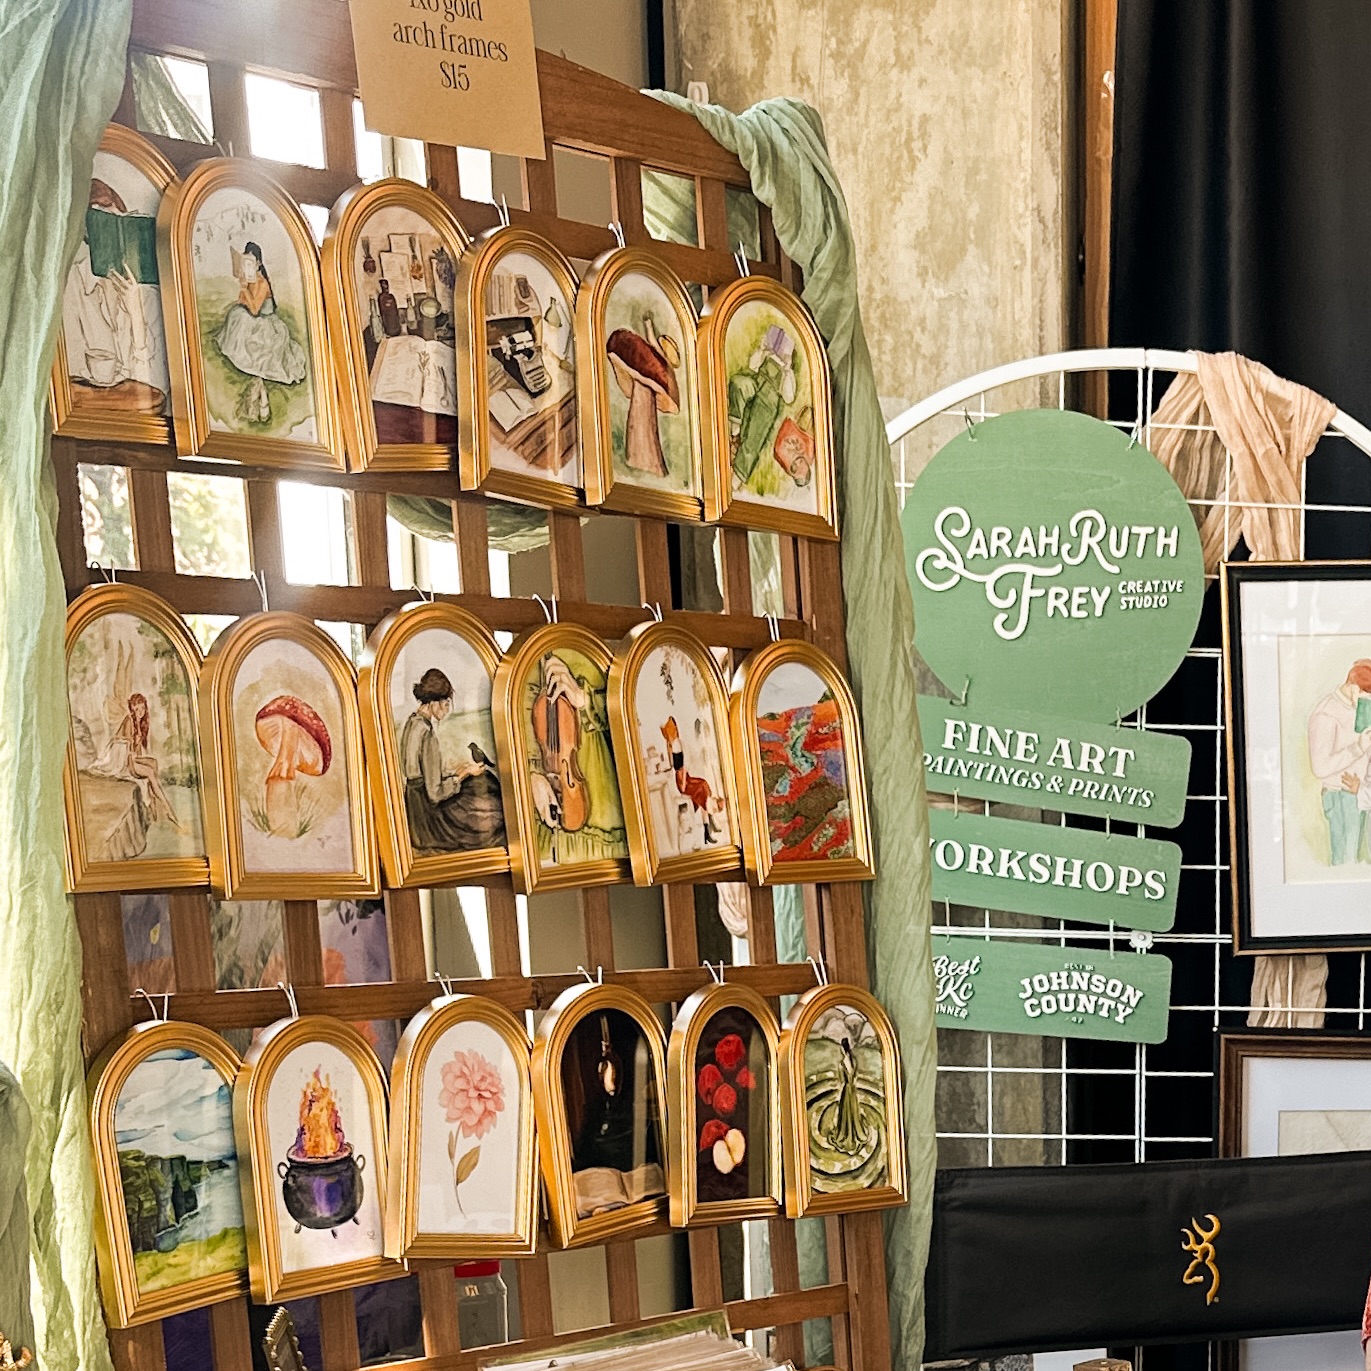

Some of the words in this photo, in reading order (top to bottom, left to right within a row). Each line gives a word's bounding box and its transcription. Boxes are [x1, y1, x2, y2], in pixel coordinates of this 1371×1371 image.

[393, 21, 436, 48] arch
[439, 24, 508, 62] frames
[439, 60, 470, 91] $15
[1118, 580, 1184, 594] CREATIVE
[1120, 595, 1168, 610] STUDIO
[941, 718, 1040, 764] FINE
[1046, 738, 1136, 779] ART
[1046, 775, 1064, 794] &
[1067, 777, 1155, 809] PRINTS
[929, 838, 1167, 901] ORKSHOPS
[932, 955, 982, 978] Best
[1018, 968, 1144, 1008] JOHNSON
[936, 1003, 968, 1020] INNER
[1024, 992, 1134, 1025] COUNTY
